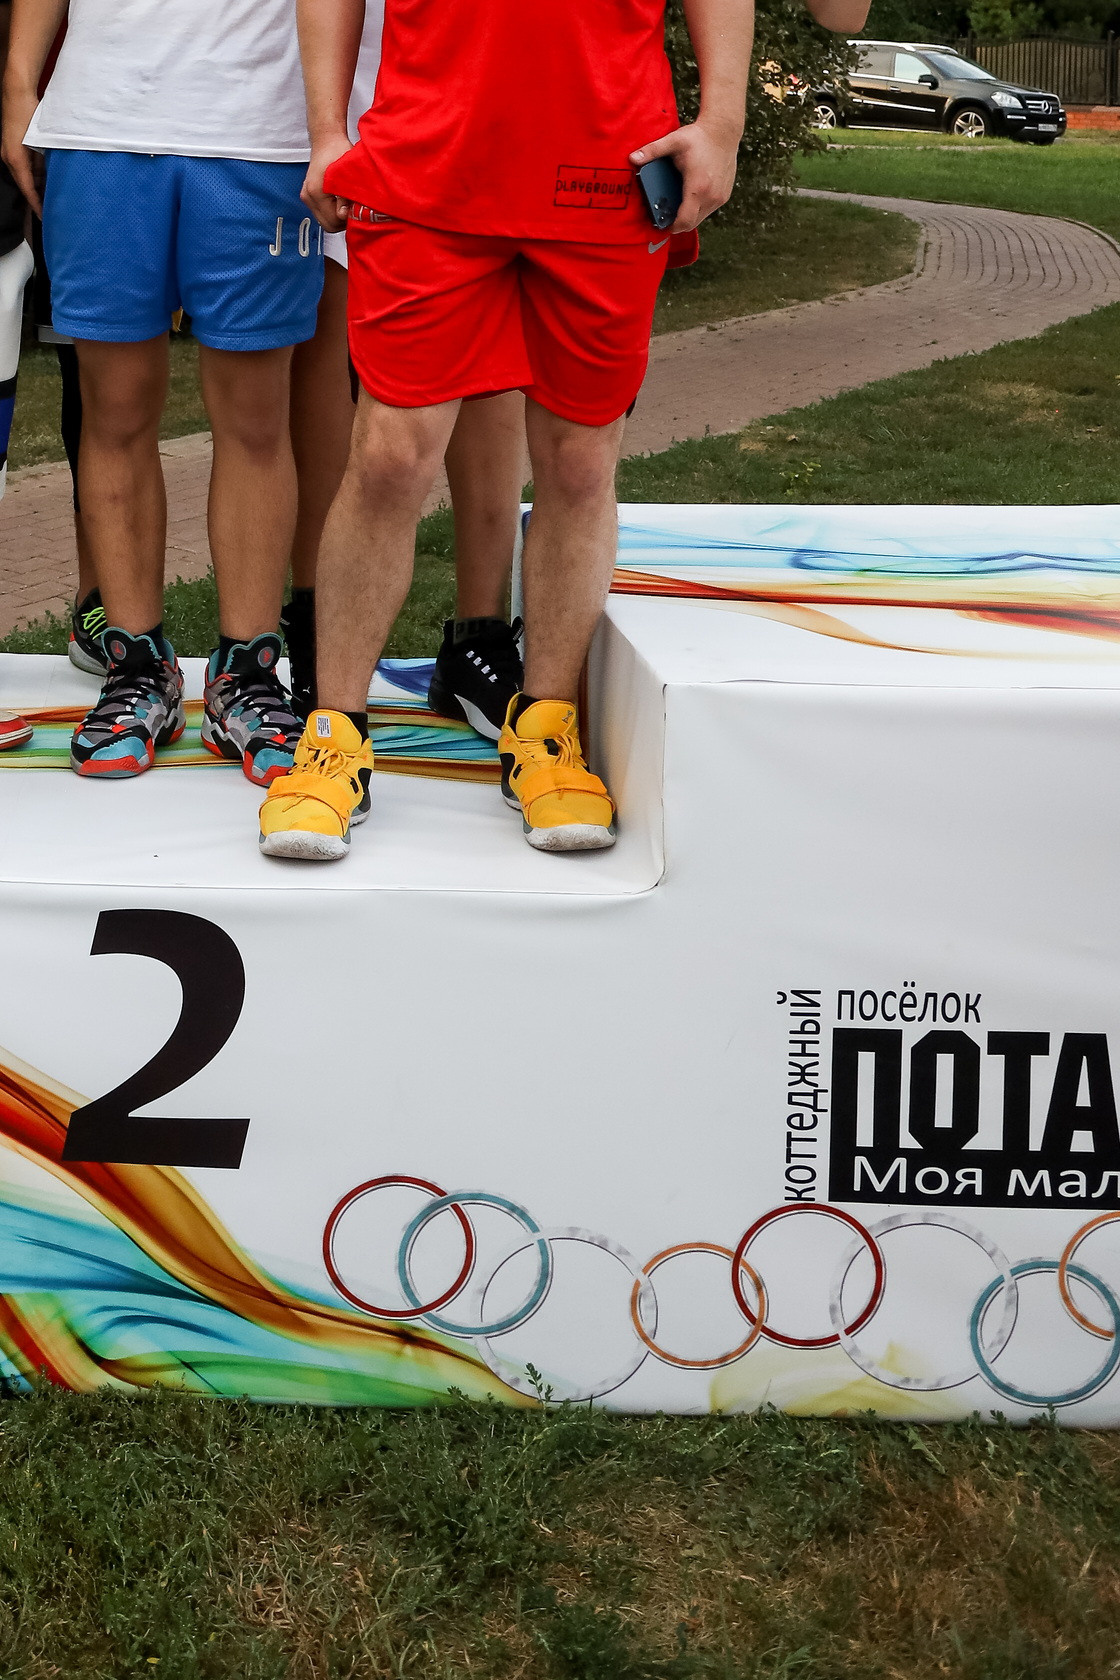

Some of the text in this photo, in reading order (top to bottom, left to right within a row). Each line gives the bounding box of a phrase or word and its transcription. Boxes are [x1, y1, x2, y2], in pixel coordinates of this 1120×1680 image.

[62, 908, 251, 1170] 2
[836, 980, 982, 1023] посёлок
[776, 989, 829, 1202] коттеджный
[830, 1027, 1120, 1152] ПОТА
[853, 1155, 983, 1196] Моя
